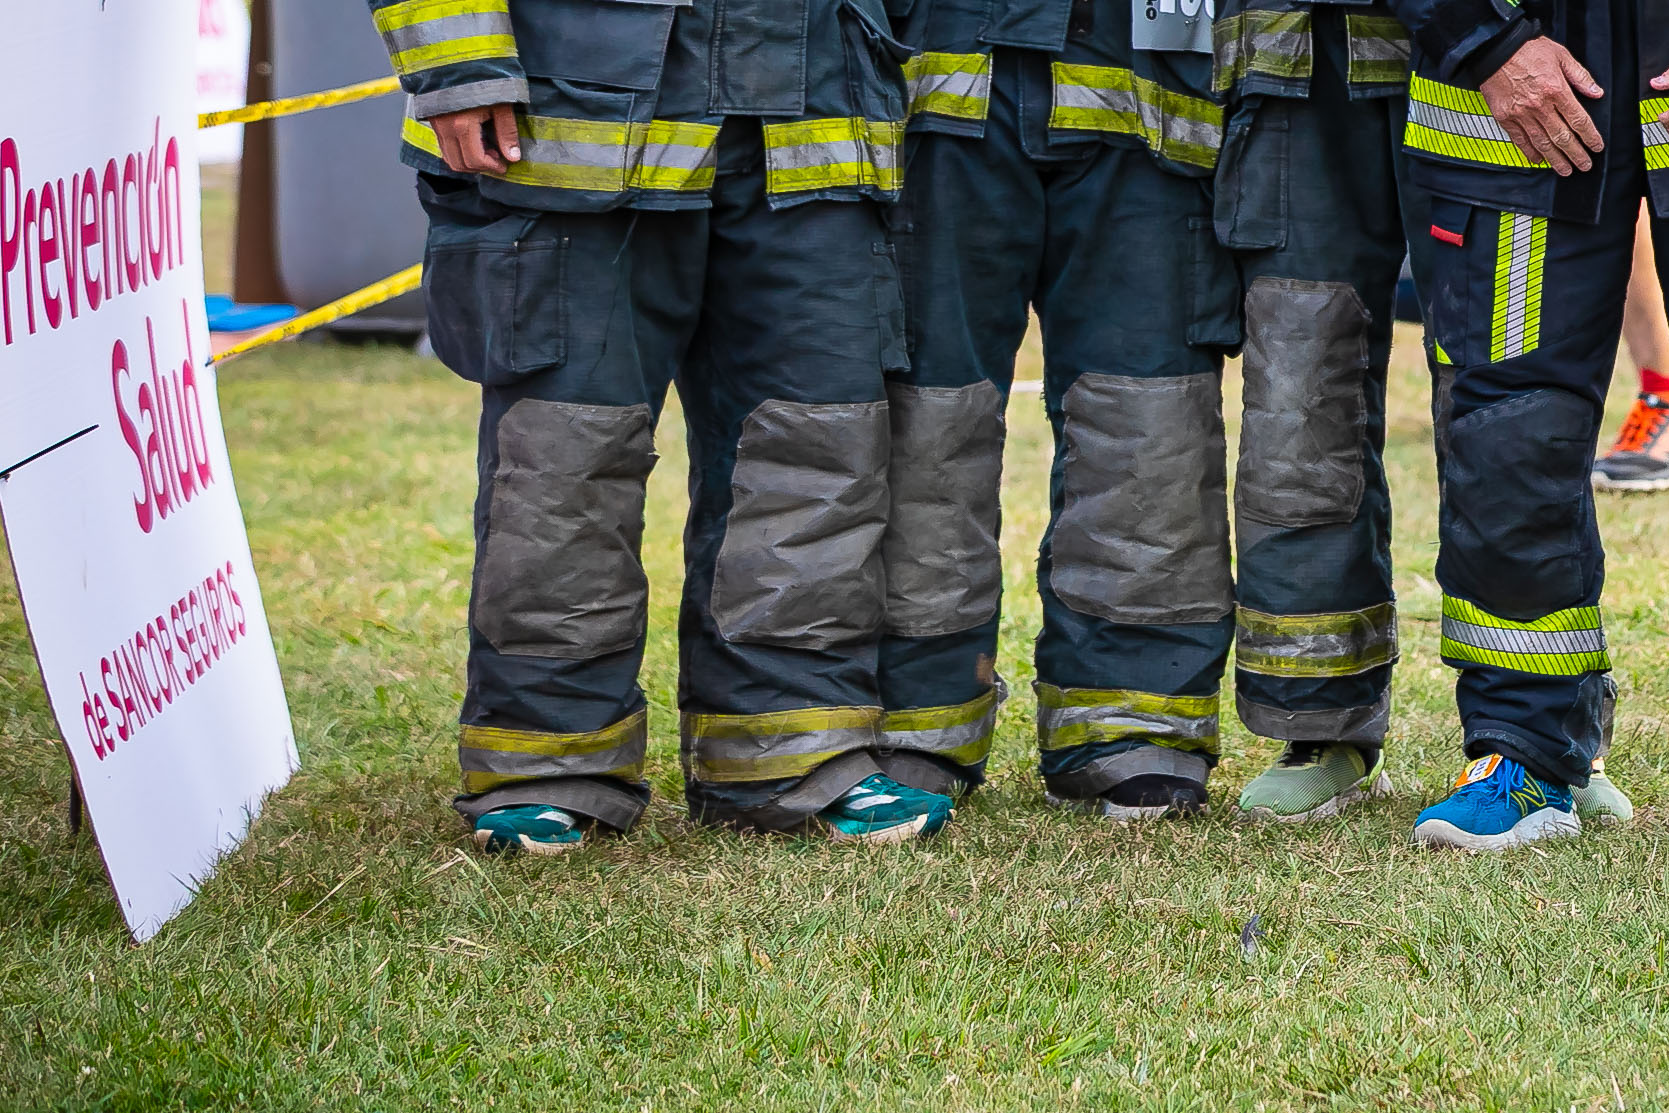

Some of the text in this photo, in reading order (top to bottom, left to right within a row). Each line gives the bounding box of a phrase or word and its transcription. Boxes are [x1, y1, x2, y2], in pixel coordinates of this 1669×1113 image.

[0, 115, 184, 345] Prevención
[111, 297, 215, 534] Salud
[79, 559, 247, 761] de SANCOR SEGUROS
